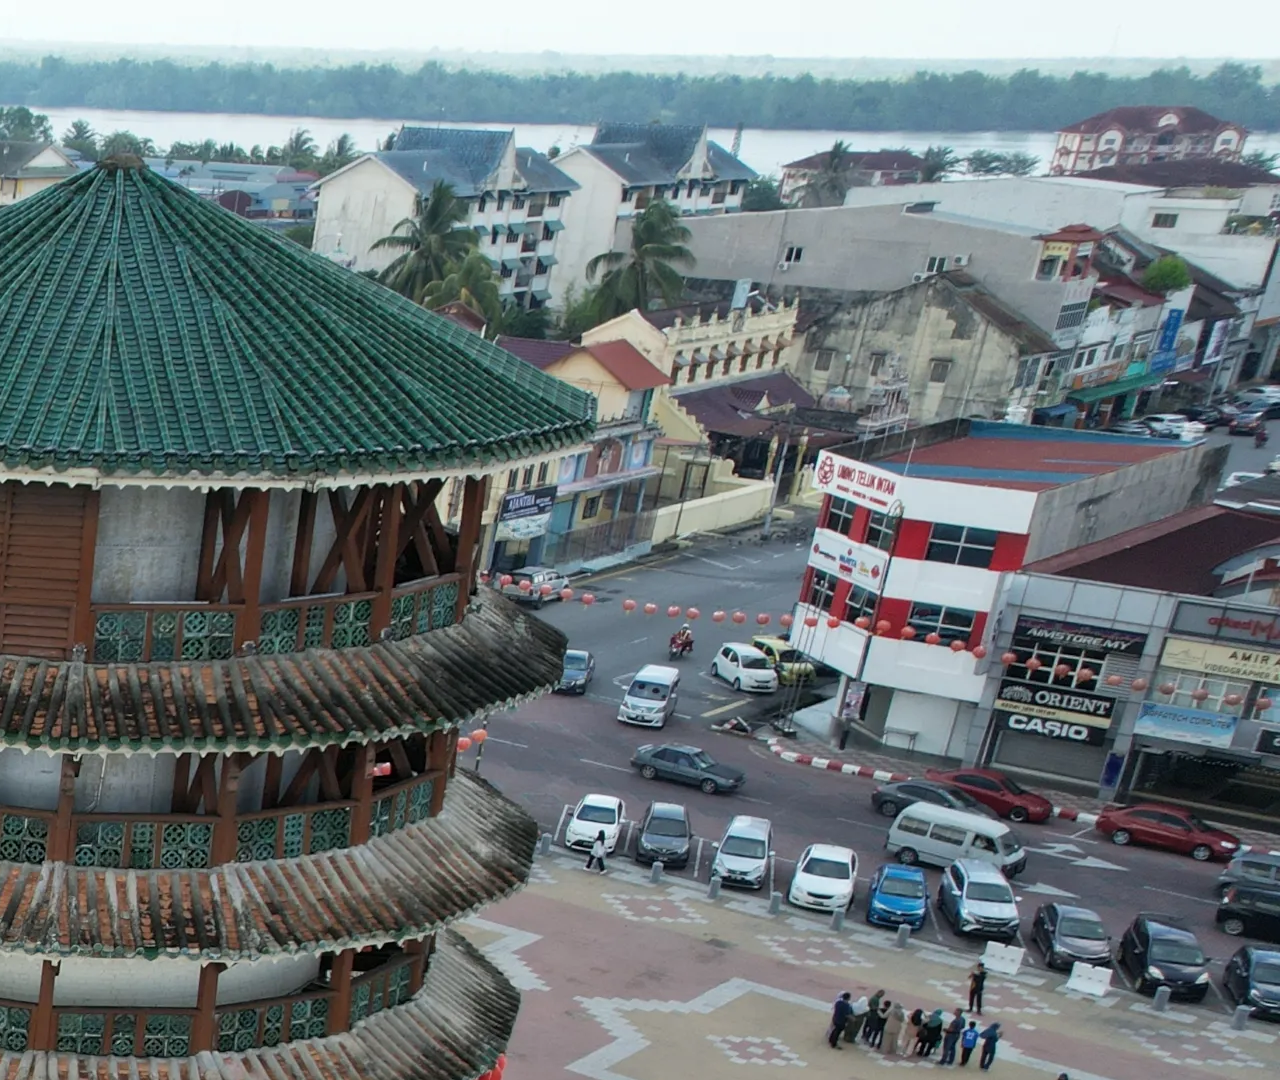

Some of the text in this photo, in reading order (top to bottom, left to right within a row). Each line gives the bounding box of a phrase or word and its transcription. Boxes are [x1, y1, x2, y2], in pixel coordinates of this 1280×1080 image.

[1228, 650, 1270, 665] AMIR
[1035, 690, 1111, 715] ORIENT
[1008, 714, 1089, 740] CASIO
